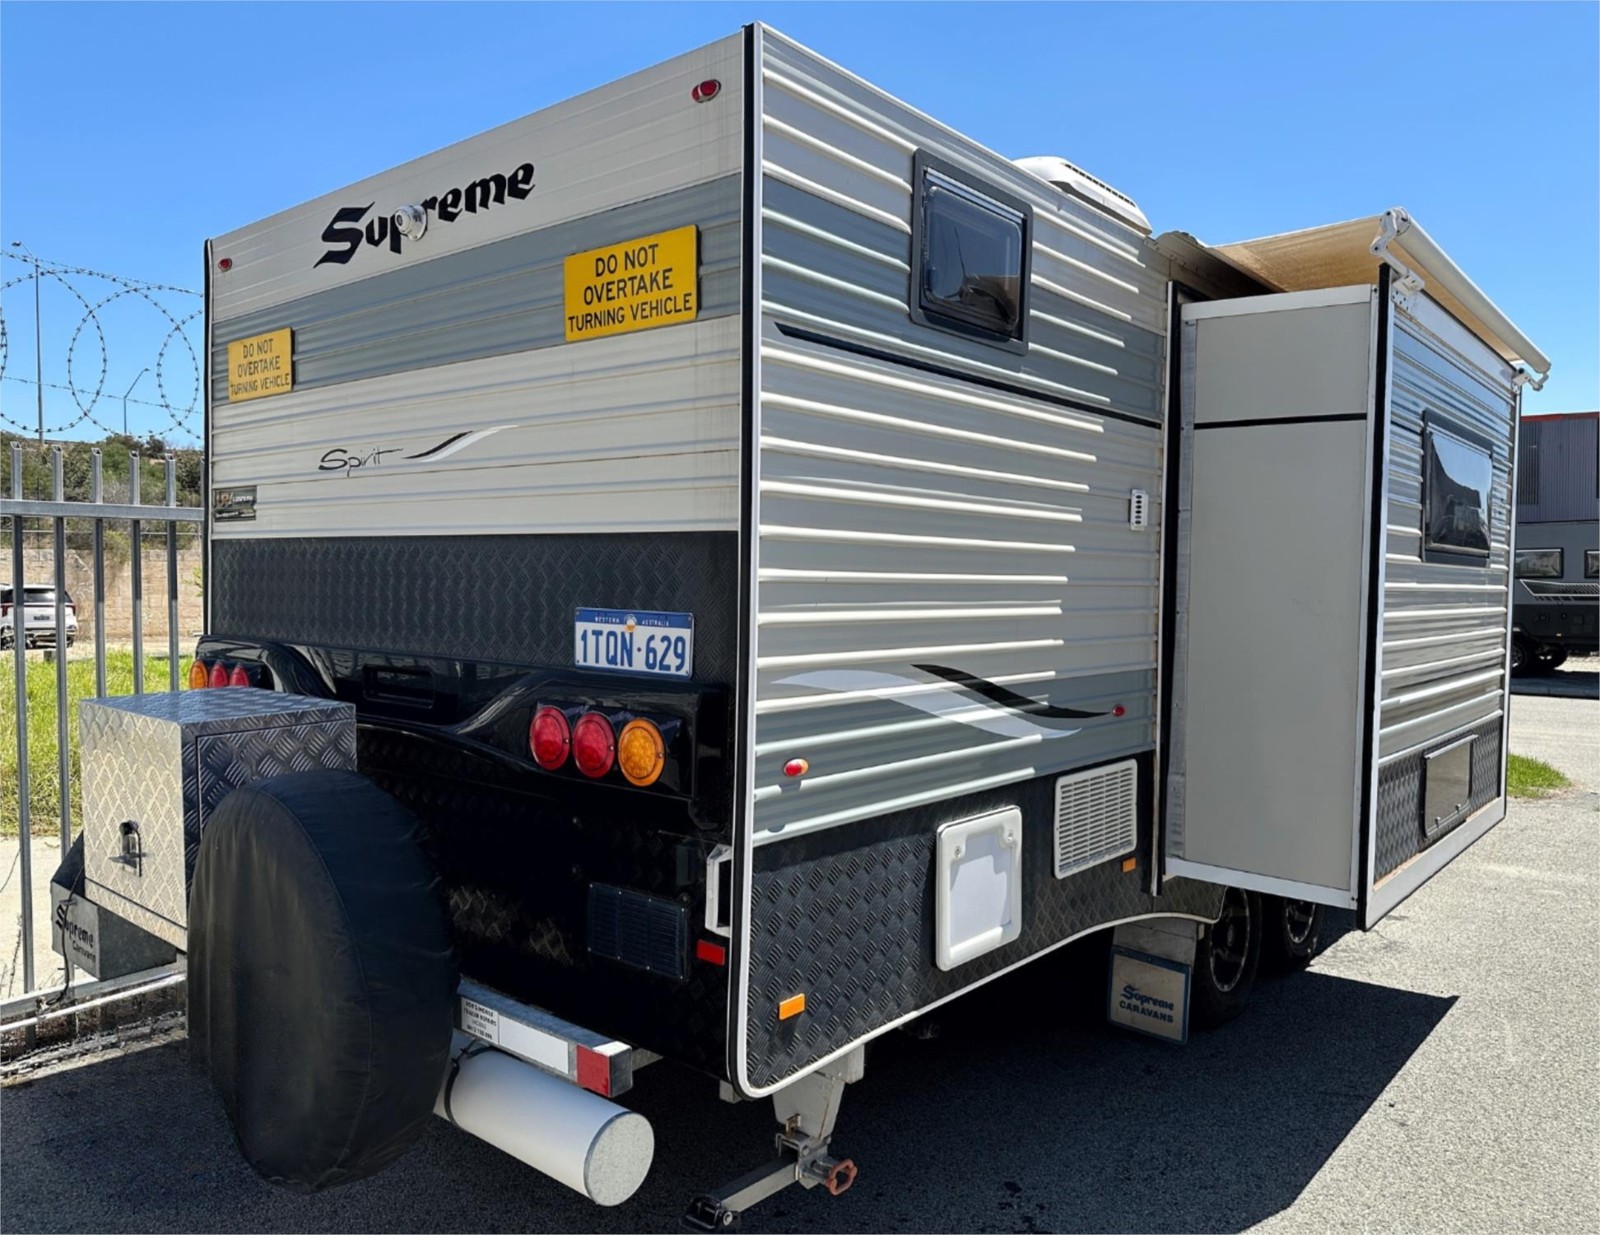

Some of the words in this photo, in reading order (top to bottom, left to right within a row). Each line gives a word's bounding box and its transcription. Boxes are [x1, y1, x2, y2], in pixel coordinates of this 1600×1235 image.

[595, 253, 618, 277] DO
[624, 243, 659, 271] NOT
[583, 267, 673, 306] OVERTAKE
[568, 306, 625, 333] TURNING
[630, 292, 693, 321] VEHICLE
[243, 343, 254, 359] DO
[257, 338, 274, 356] NOT
[237, 355, 281, 378] OVERTAKE
[230, 379, 258, 397] TURNING
[260, 373, 290, 391] VEHICLE
[318, 448, 404, 478] Spirit
[1119, 1000, 1174, 1023] CARAVANS
